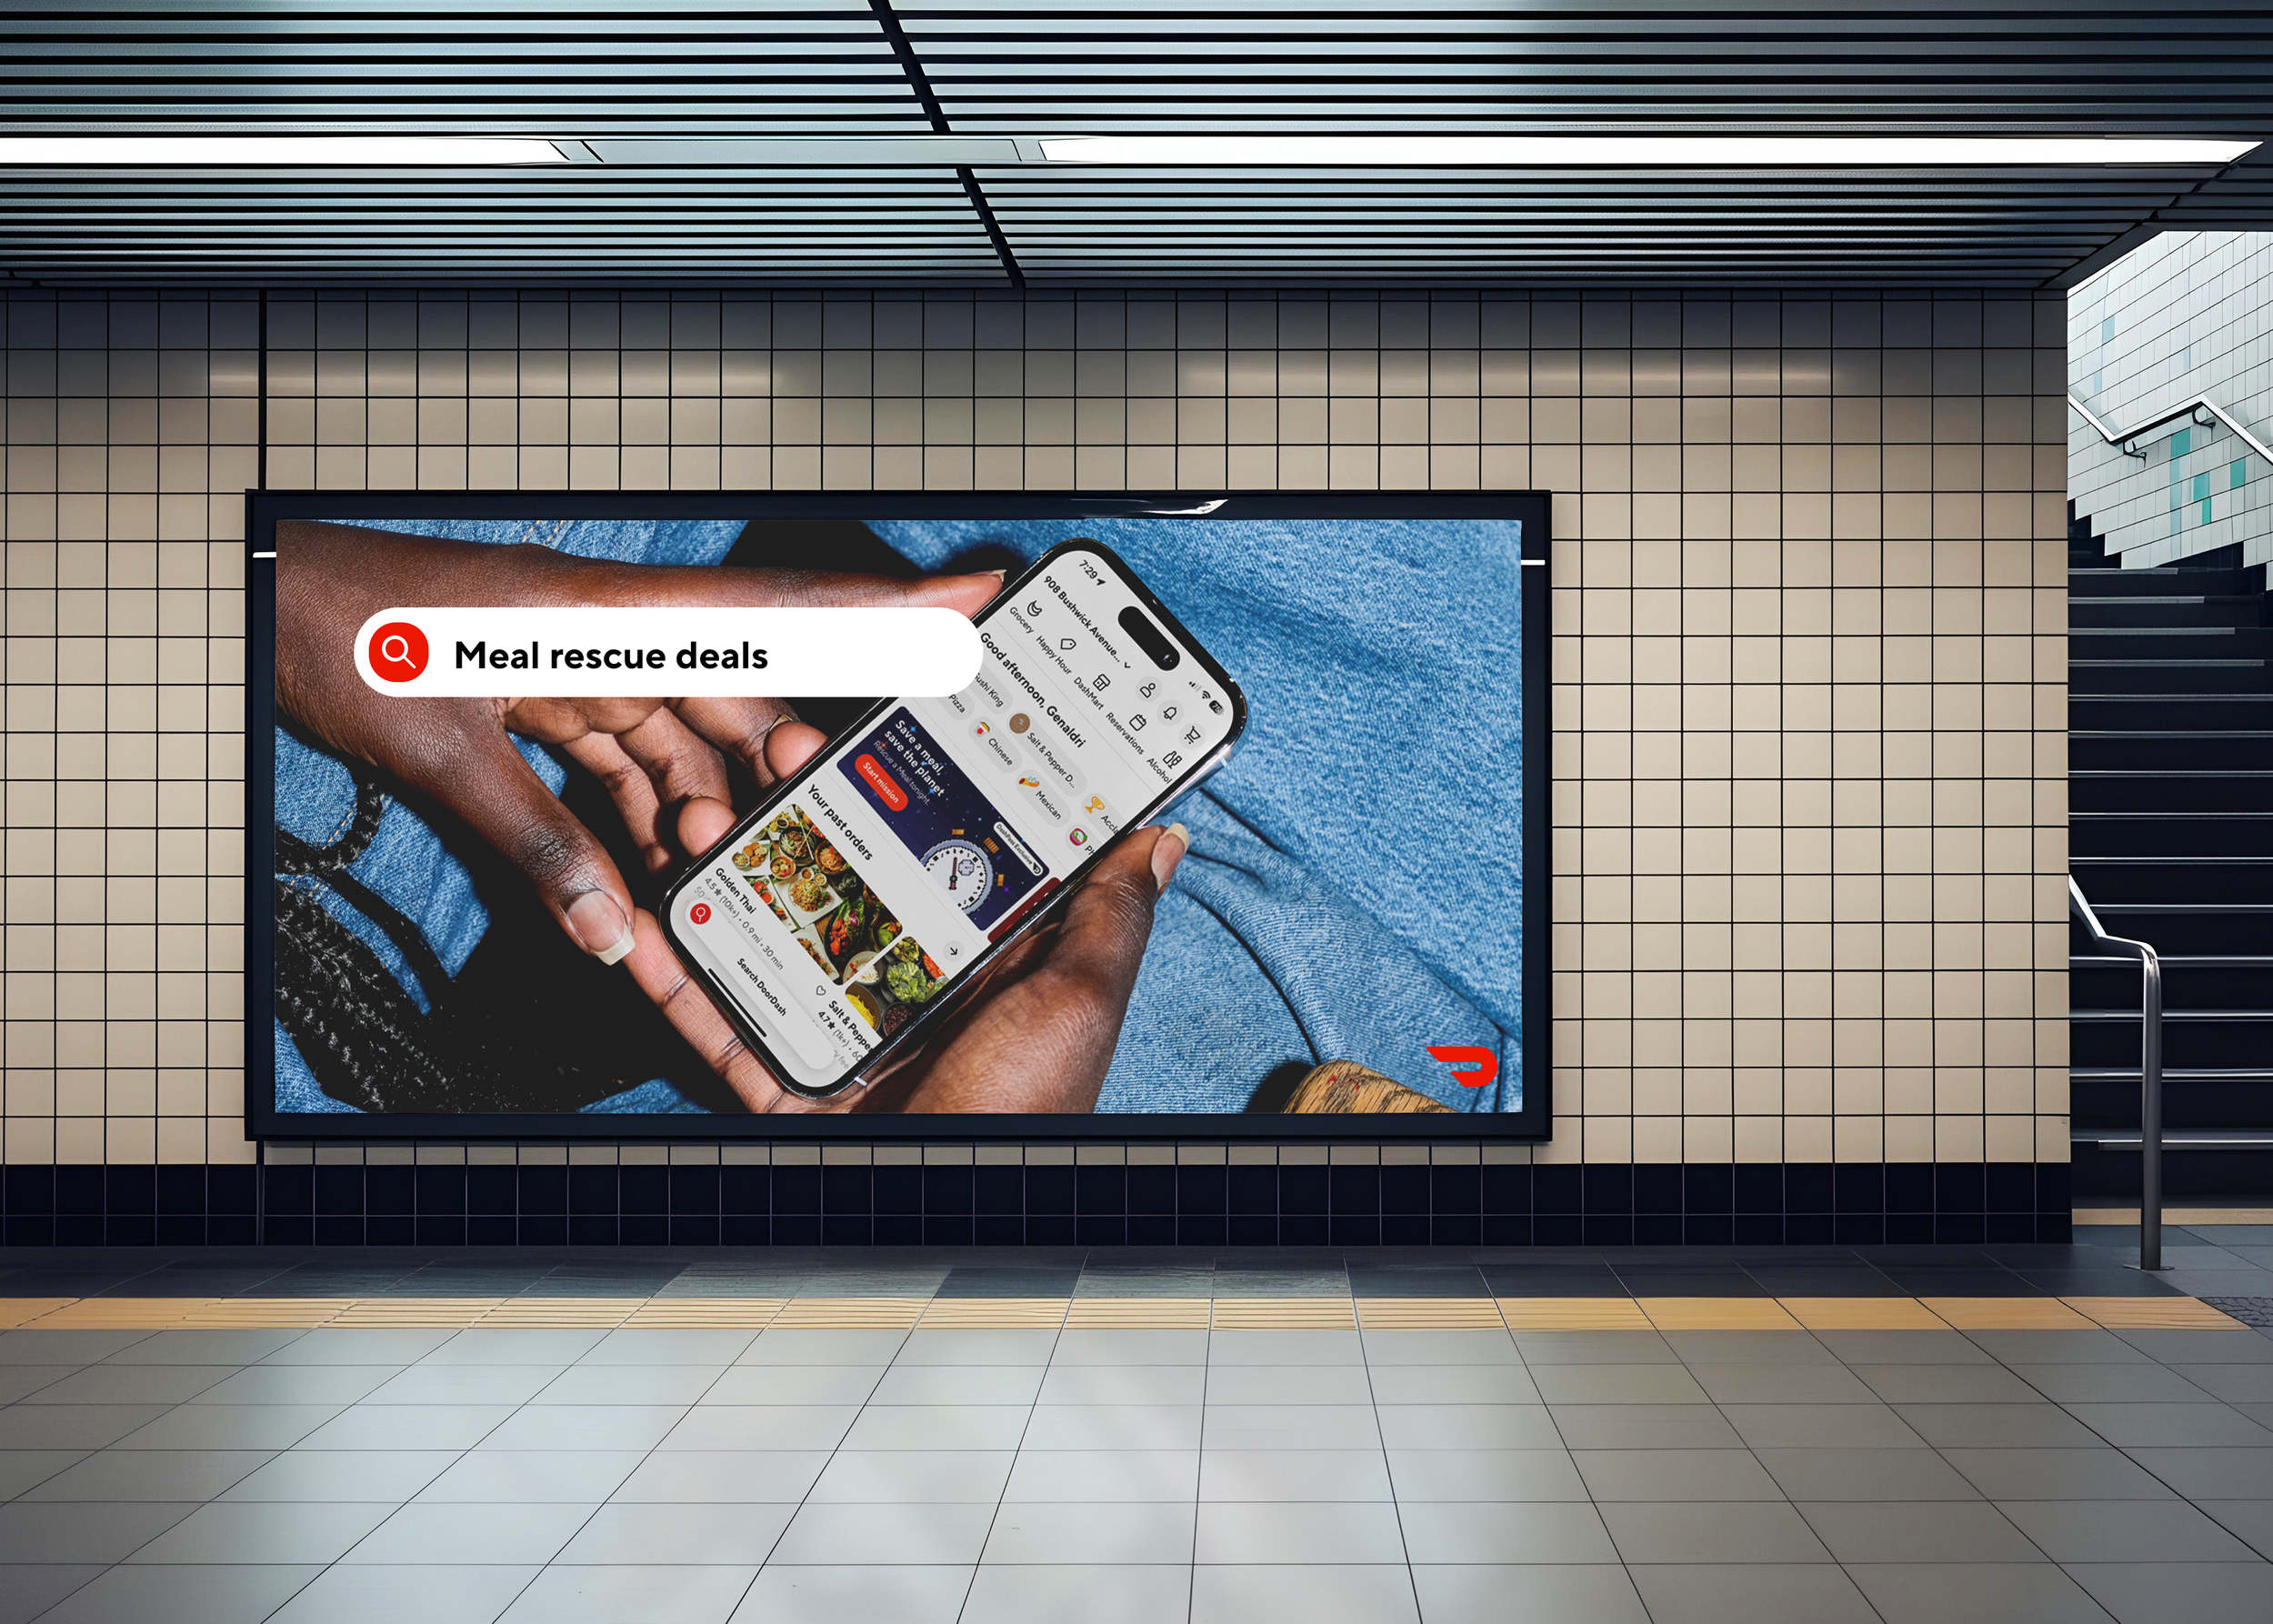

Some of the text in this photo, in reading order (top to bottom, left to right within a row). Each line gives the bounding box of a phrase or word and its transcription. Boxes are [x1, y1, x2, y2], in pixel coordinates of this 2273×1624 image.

[1078, 559, 1098, 579] 7:29
[1009, 606, 1035, 634] Grocery
[1044, 575, 1061, 594] 908
[1057, 590, 1092, 629] Bushwick
[456, 640, 769, 669] Meal rescue deals
[1036, 635, 1072, 675] Happy Hour
[947, 693, 966, 714] Pizza
[980, 632, 1007, 661] Good
[1002, 658, 1046, 708] afternoon,
[1046, 705, 1086, 748] Genaldri
[987, 688, 1004, 707] King
[1073, 676, 1105, 710] DashMart
[895, 719, 945, 776] Save a meal,
[987, 737, 1013, 766] Chinese
[1026, 732, 1041, 748] Salt
[1038, 745, 1046, 754] &
[1043, 750, 1067, 777] Pepper
[1105, 711, 1145, 756] Reservations
[862, 761, 899, 804] Start mission
[872, 739, 896, 766] Rescue
[896, 766, 913, 784] Meal
[884, 730, 945, 797] save the planet
[1146, 757, 1173, 785] Alcohol
[807, 783, 873, 861] Your past orders
[1035, 790, 1061, 820] Mexican
[996, 823, 1033, 865] DashPass Exclusive
[716, 867, 741, 897] Golden
[739, 893, 756, 915] Thai
[705, 877, 717, 890] 4.5
[718, 895, 740, 918] (10k+)
[741, 920, 755, 934] 0.9
[751, 933, 763, 944] mi
[762, 945, 774, 957] 30
[770, 956, 784, 970] min
[736, 957, 786, 1017] Search DoorDash
[817, 1011, 831, 1022] 4.7
[832, 1028, 850, 1048] (1k+)
[828, 999, 845, 1018] Salt
[841, 1016, 851, 1026] &
